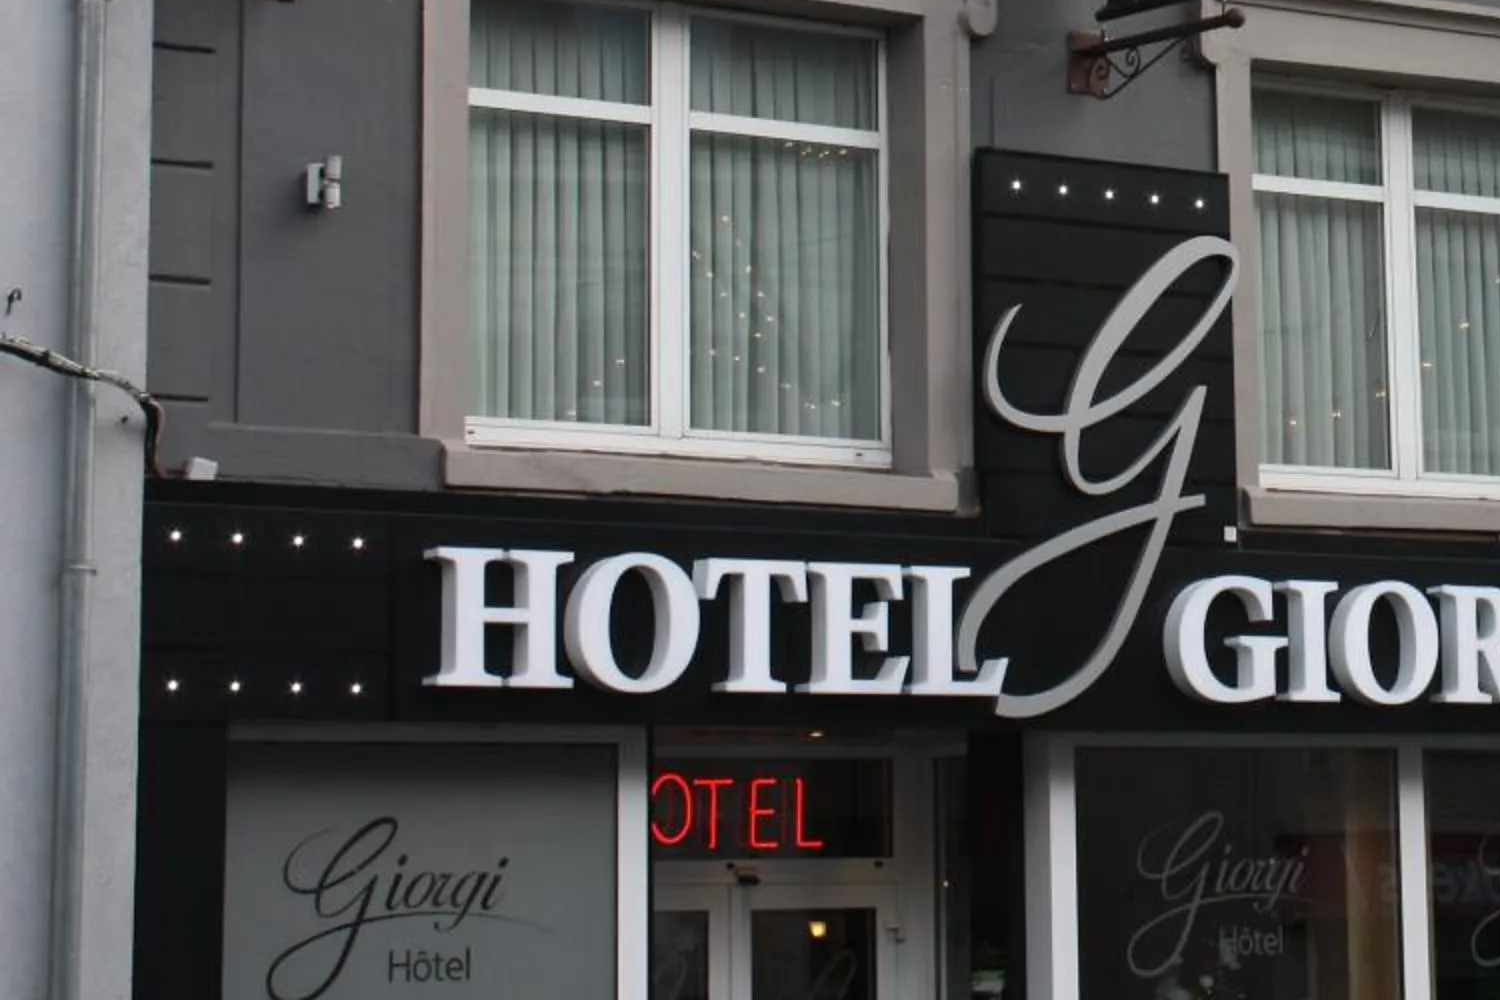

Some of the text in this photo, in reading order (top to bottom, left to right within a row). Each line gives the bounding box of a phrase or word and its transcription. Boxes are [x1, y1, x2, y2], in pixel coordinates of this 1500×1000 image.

[422, 546, 1009, 696] HOTEL
[265, 815, 550, 1000] Giorgi
[388, 947, 471, 983] Hôtel
[1126, 810, 1312, 978] Giorgi
